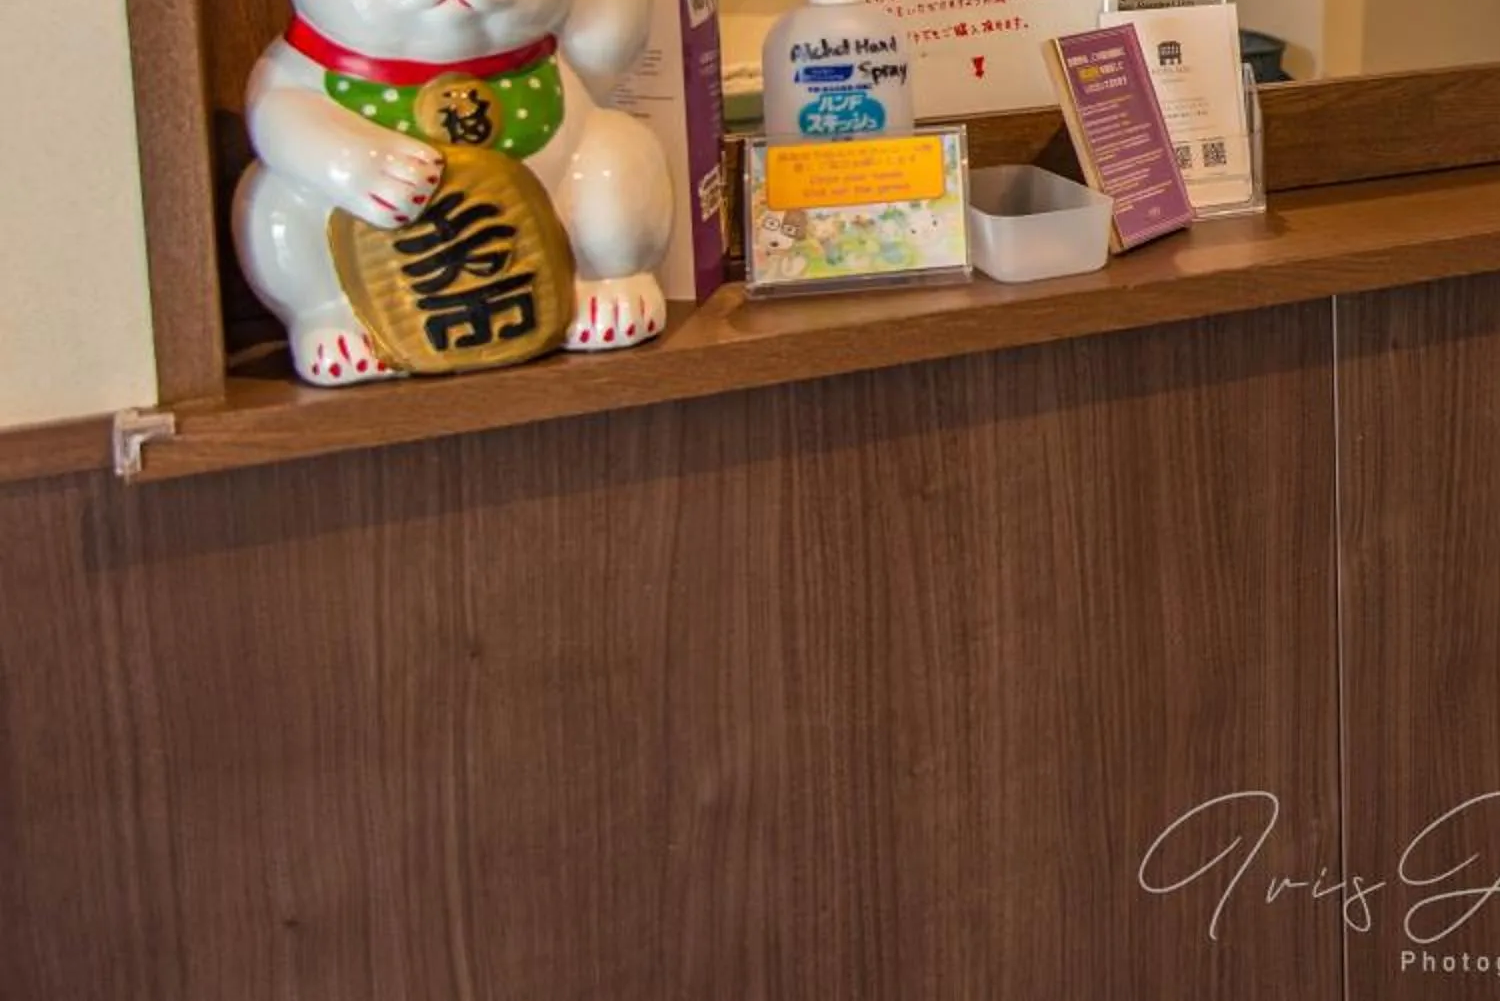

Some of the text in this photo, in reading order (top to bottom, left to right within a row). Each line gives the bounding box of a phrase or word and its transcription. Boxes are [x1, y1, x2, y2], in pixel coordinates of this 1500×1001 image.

[855, 35, 896, 55] Hand
[858, 61, 907, 85] Spray
[819, 94, 864, 112] ハンド
